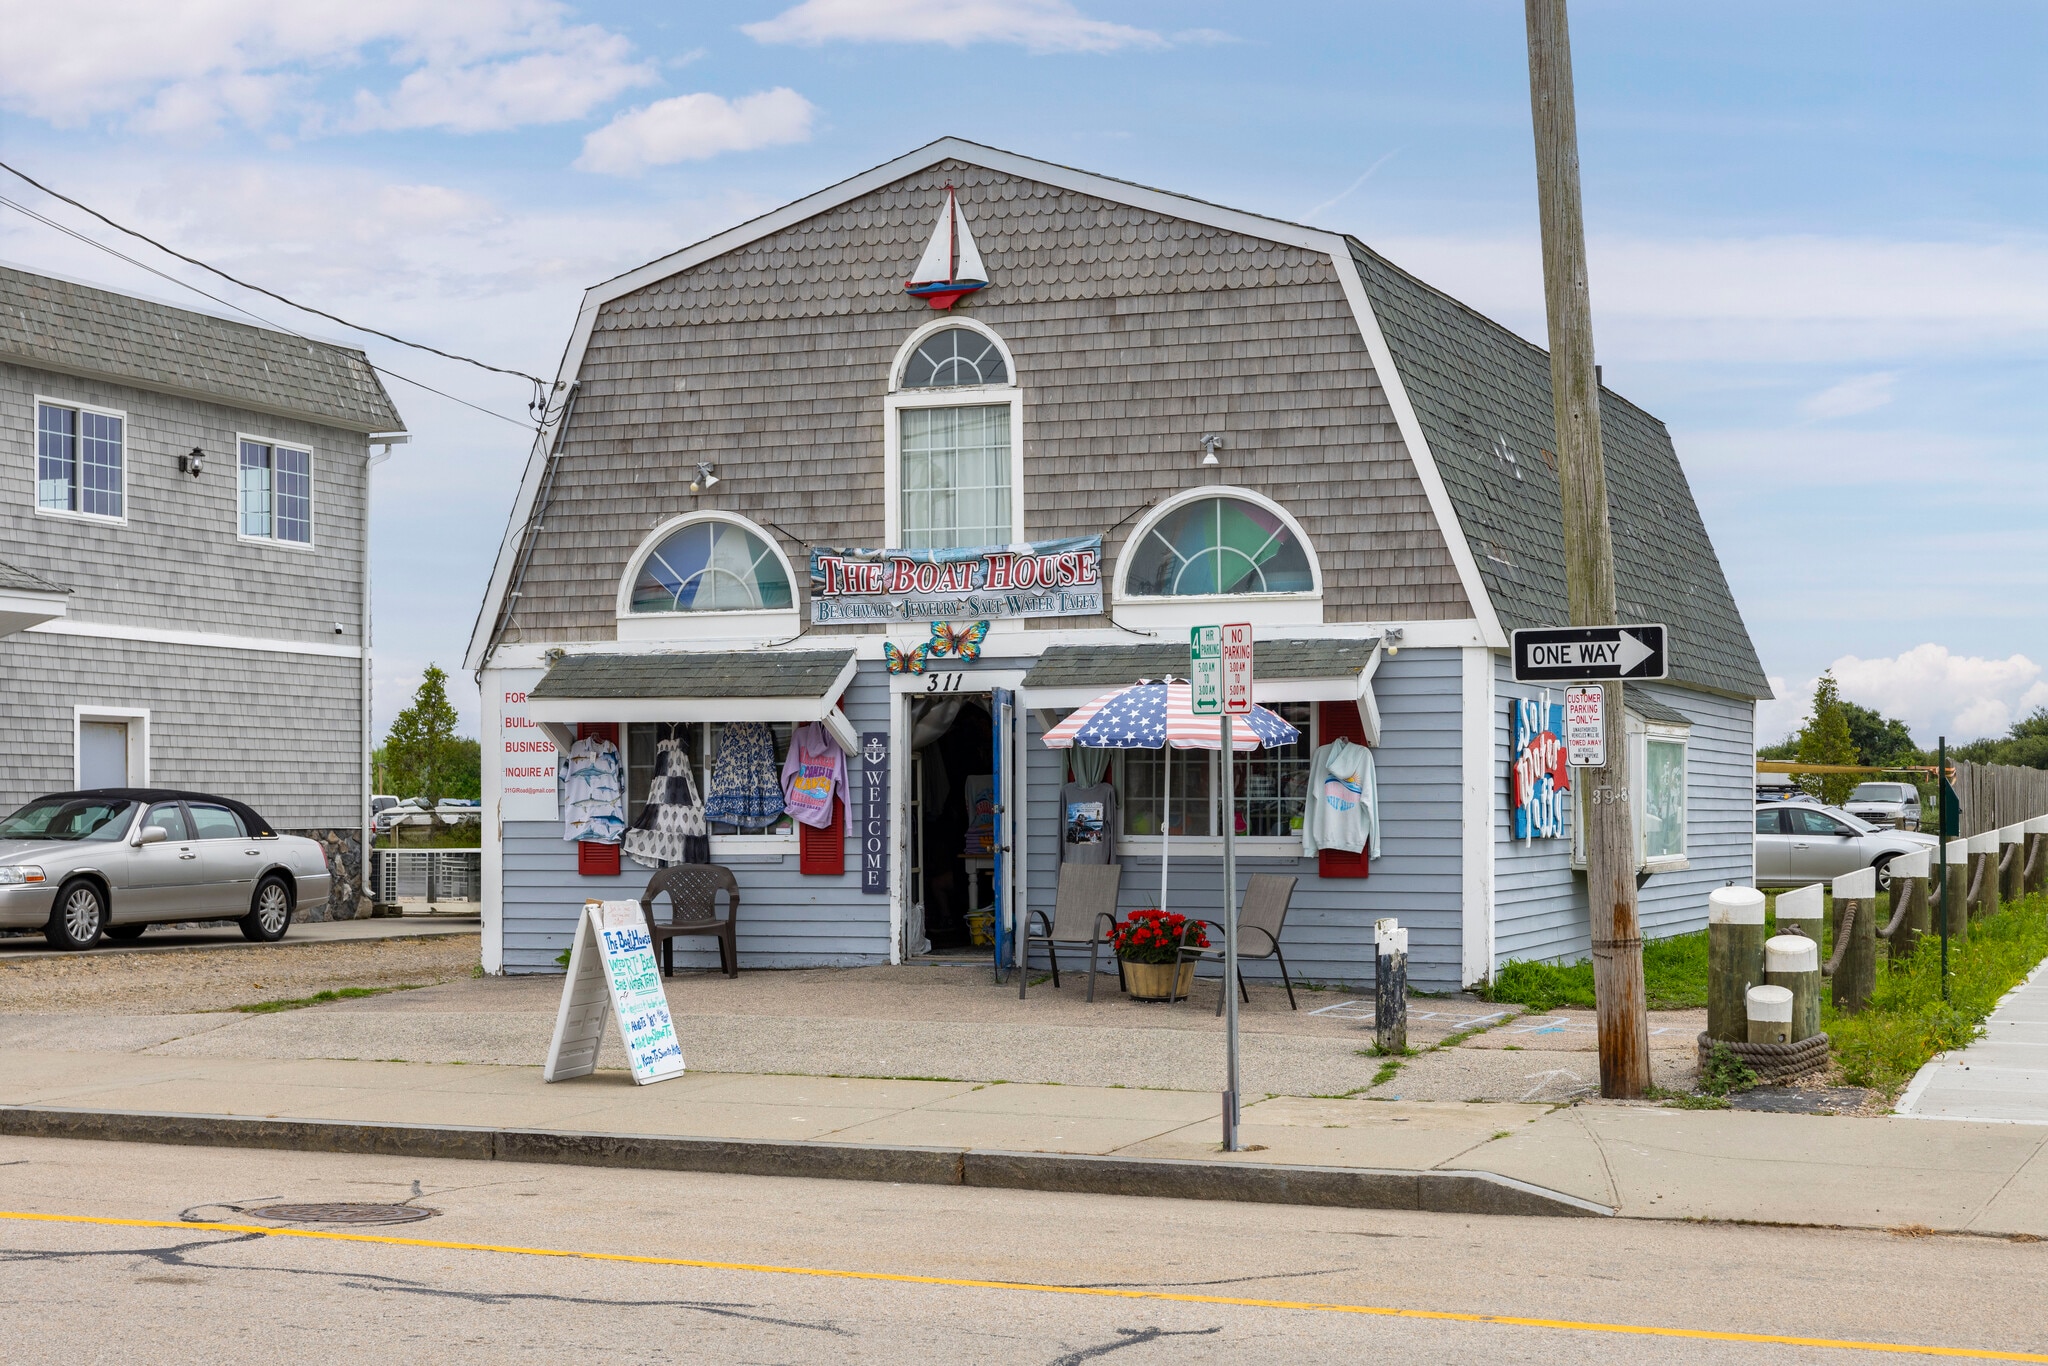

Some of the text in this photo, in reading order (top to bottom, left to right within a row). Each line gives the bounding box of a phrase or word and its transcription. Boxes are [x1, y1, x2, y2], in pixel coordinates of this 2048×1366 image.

[817, 549, 1097, 596] THE BOAT HOUSE
[817, 591, 1099, 621] BEACHWARE JEWELRY SALT WATER TAFFY
[1192, 630, 1214, 654] 4 HR
[1231, 629, 1243, 644] NO
[1201, 644, 1220, 656] PARKING
[1225, 645, 1250, 659] PARKING
[1532, 643, 1620, 665] ONE WAY
[927, 673, 963, 691] 311
[505, 692, 527, 704] FOR
[1567, 694, 1601, 703] CUSTOMER
[1570, 705, 1598, 714] PARKING
[1575, 715, 1593, 724] ONLY
[505, 741, 556, 753] BUSINESS
[1587, 739, 1602, 747] AWAY
[505, 767, 555, 777] INQUIRE AT
[865, 771, 885, 885] WELCOME
